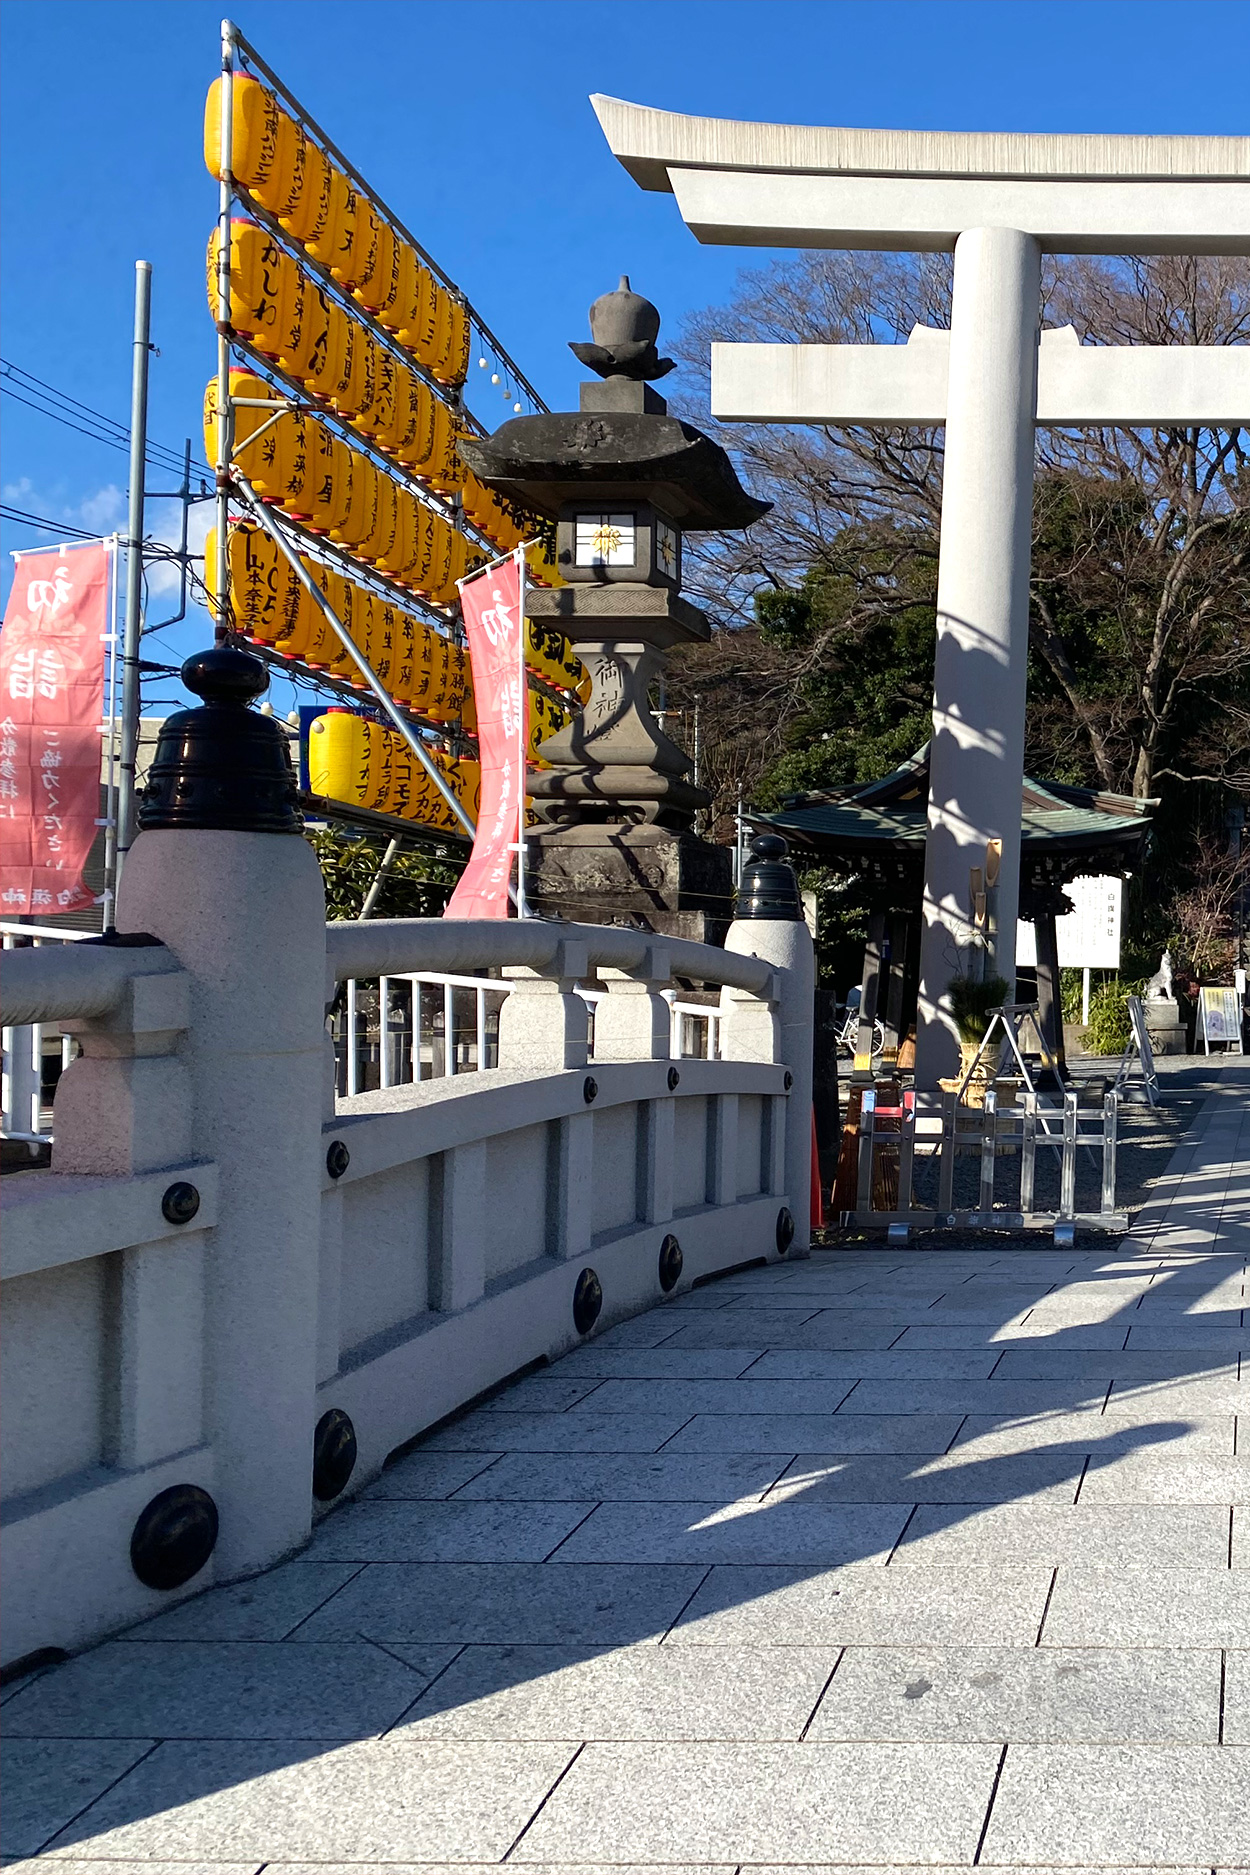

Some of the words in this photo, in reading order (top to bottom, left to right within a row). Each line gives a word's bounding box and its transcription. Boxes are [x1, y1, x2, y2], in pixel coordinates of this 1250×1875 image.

[252, 239, 279, 326] かしわ
[373, 352, 395, 427] エキスパート
